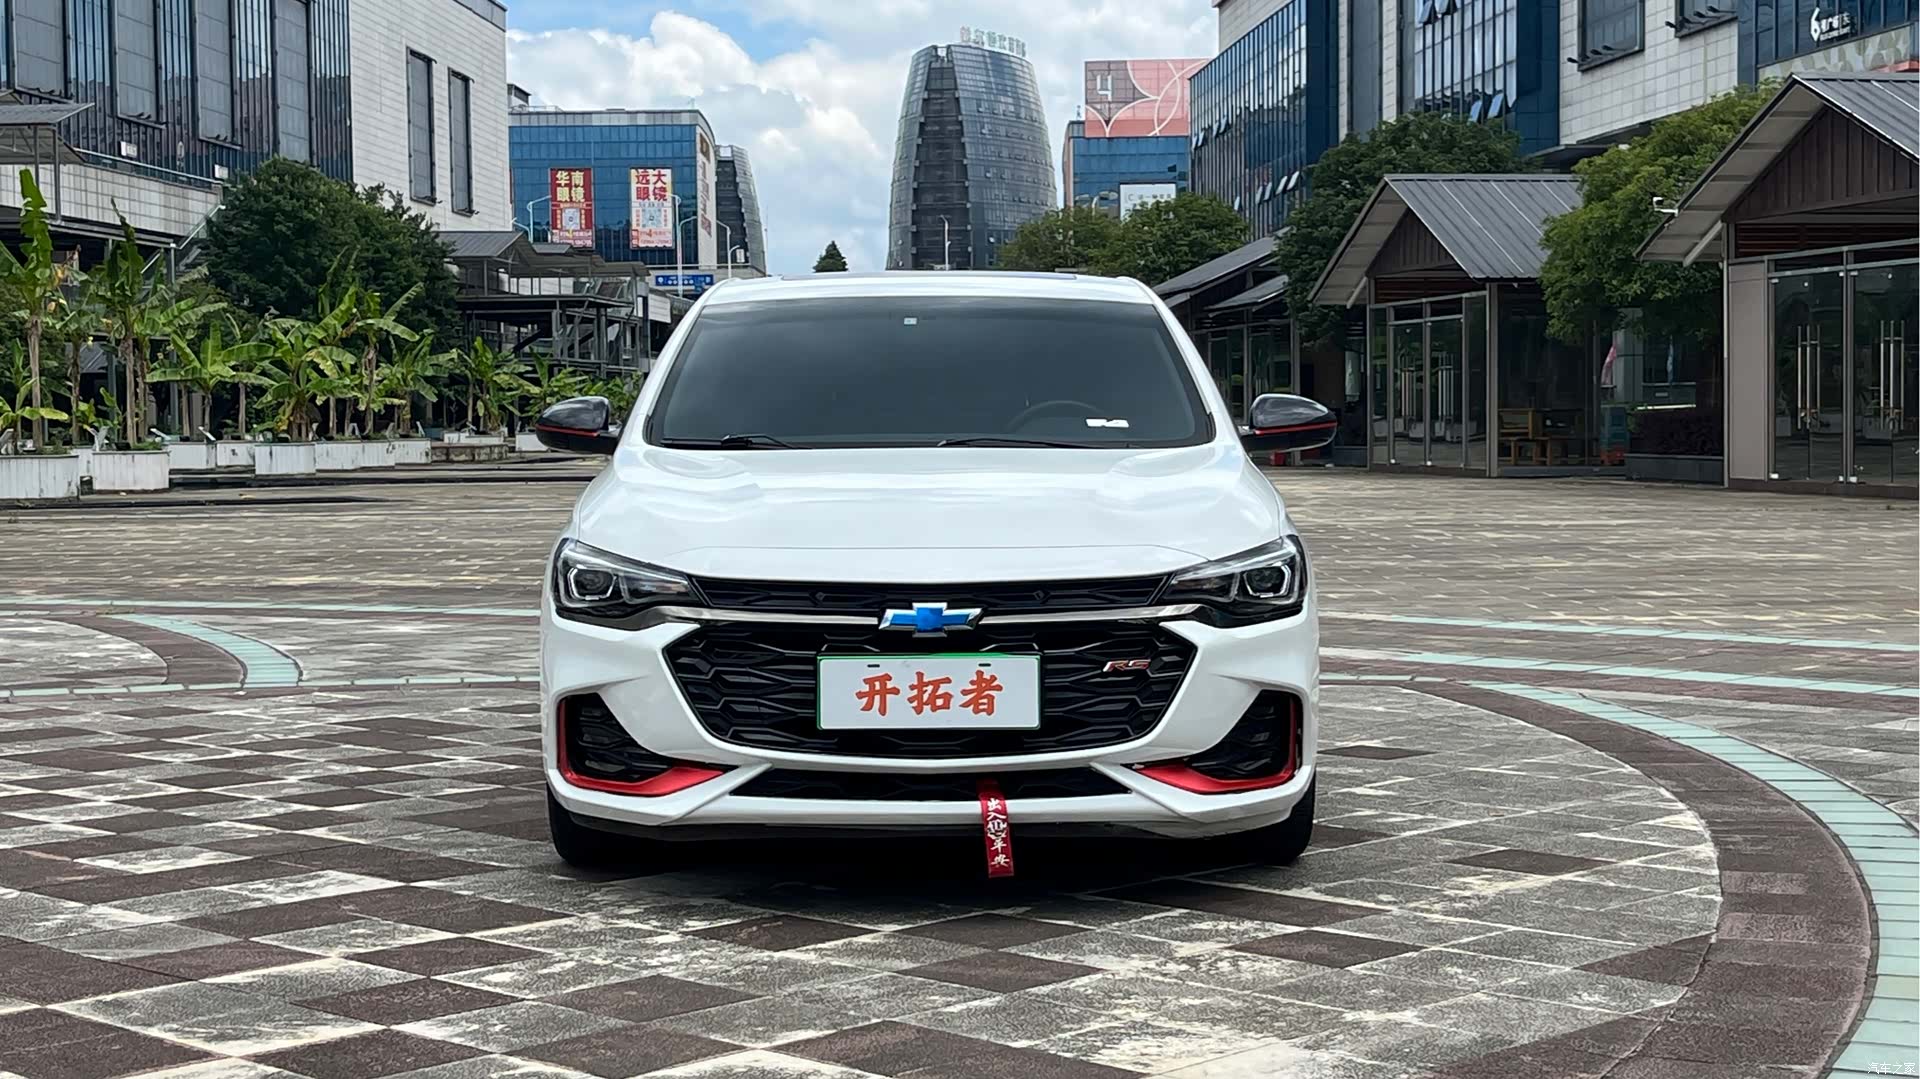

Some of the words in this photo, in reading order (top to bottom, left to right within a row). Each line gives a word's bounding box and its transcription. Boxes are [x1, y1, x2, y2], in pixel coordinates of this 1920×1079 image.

[556, 170, 584, 187] 华南
[635, 169, 666, 186] 远大
[556, 186, 585, 202] 眼镜
[636, 186, 668, 202] 眼镜
[1102, 659, 1151, 672] RS
[855, 669, 1004, 717] 开拓者
